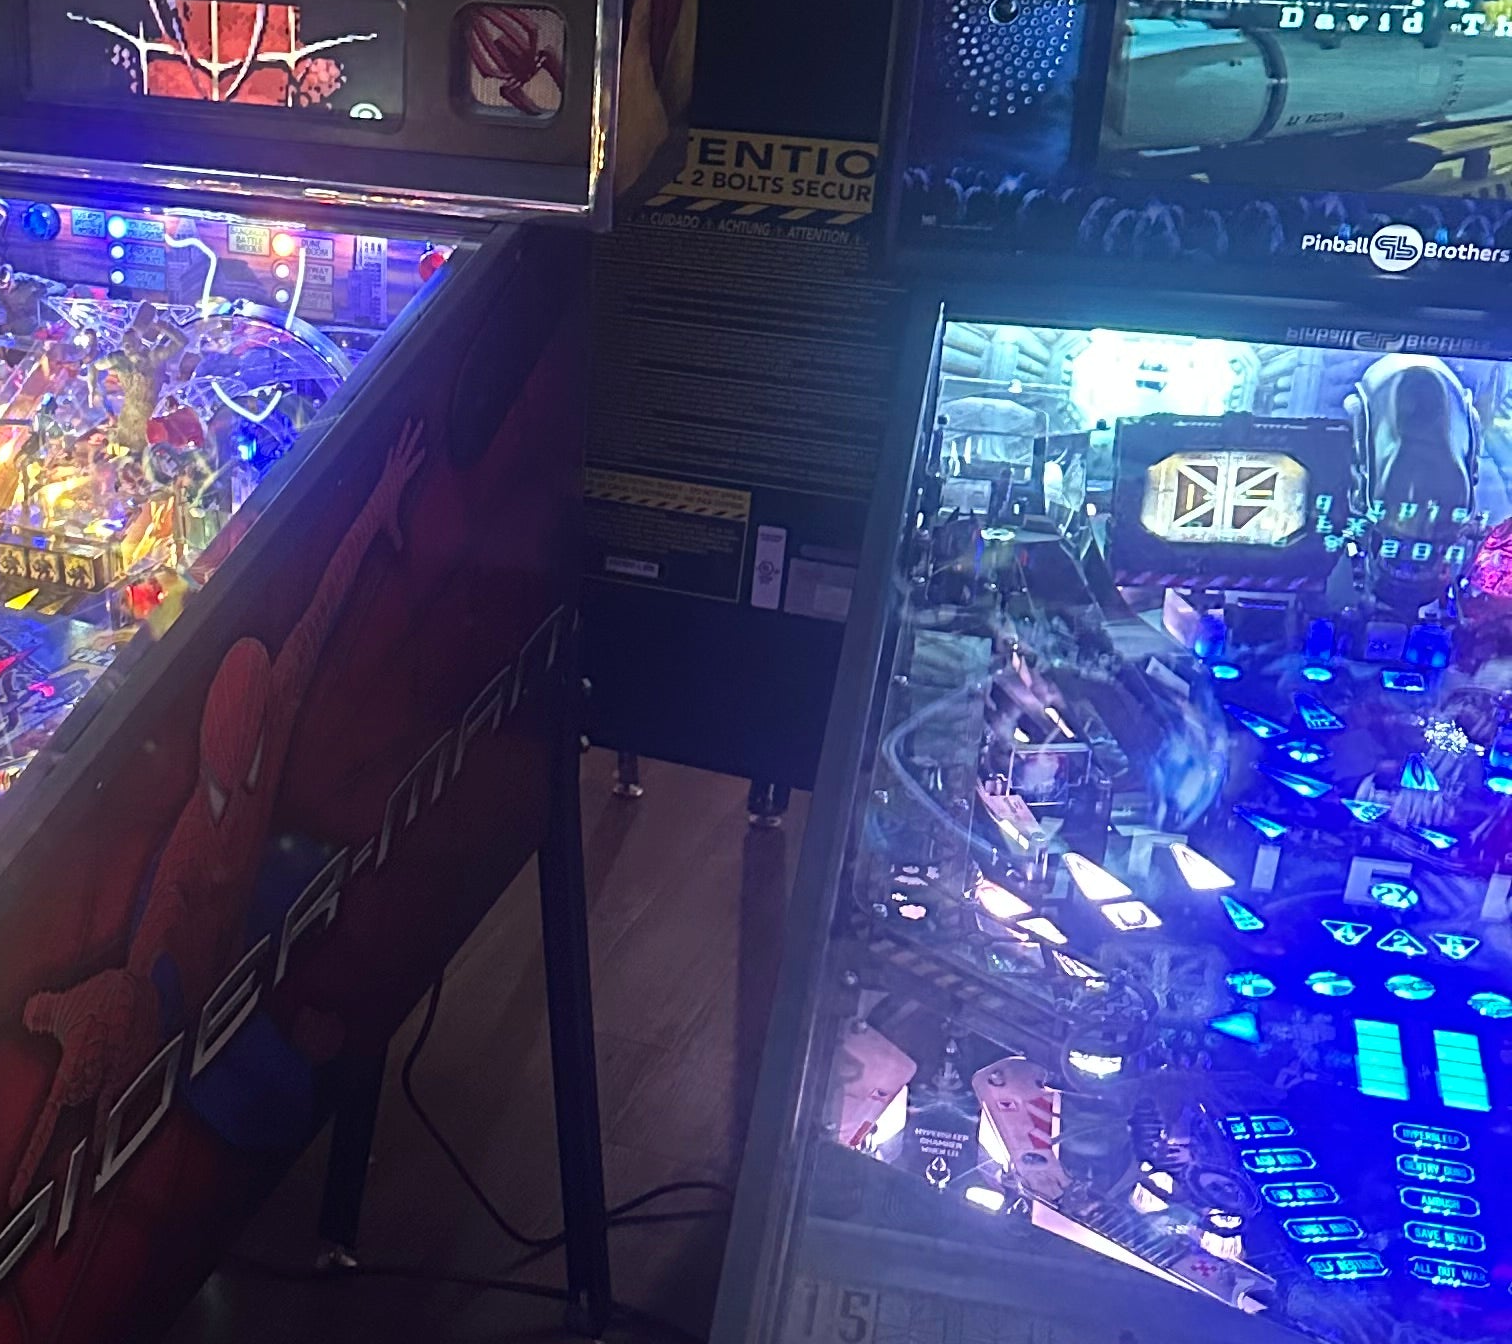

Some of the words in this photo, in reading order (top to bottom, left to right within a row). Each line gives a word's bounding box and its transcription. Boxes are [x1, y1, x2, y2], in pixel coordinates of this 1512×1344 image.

[1279, 6, 1424, 35] David
[690, 136, 877, 180] ENTIO
[691, 169, 705, 187] 2
[712, 172, 784, 195] BOLTS
[791, 178, 872, 203] SECUR
[650, 212, 700, 229] CUIDADO
[717, 218, 771, 237] ACHTUNG
[788, 225, 850, 244] ATTENTION
[1301, 233, 1369, 256] Pinball
[1423, 242, 1510, 264] Brothers
[1393, 935, 1410, 949] 2
[1414, 1227, 1441, 1241] SAVE
[1443, 1231, 1475, 1247] NEWT
[1413, 1261, 1433, 1275] ALL
[1460, 1268, 1486, 1282] WAR
